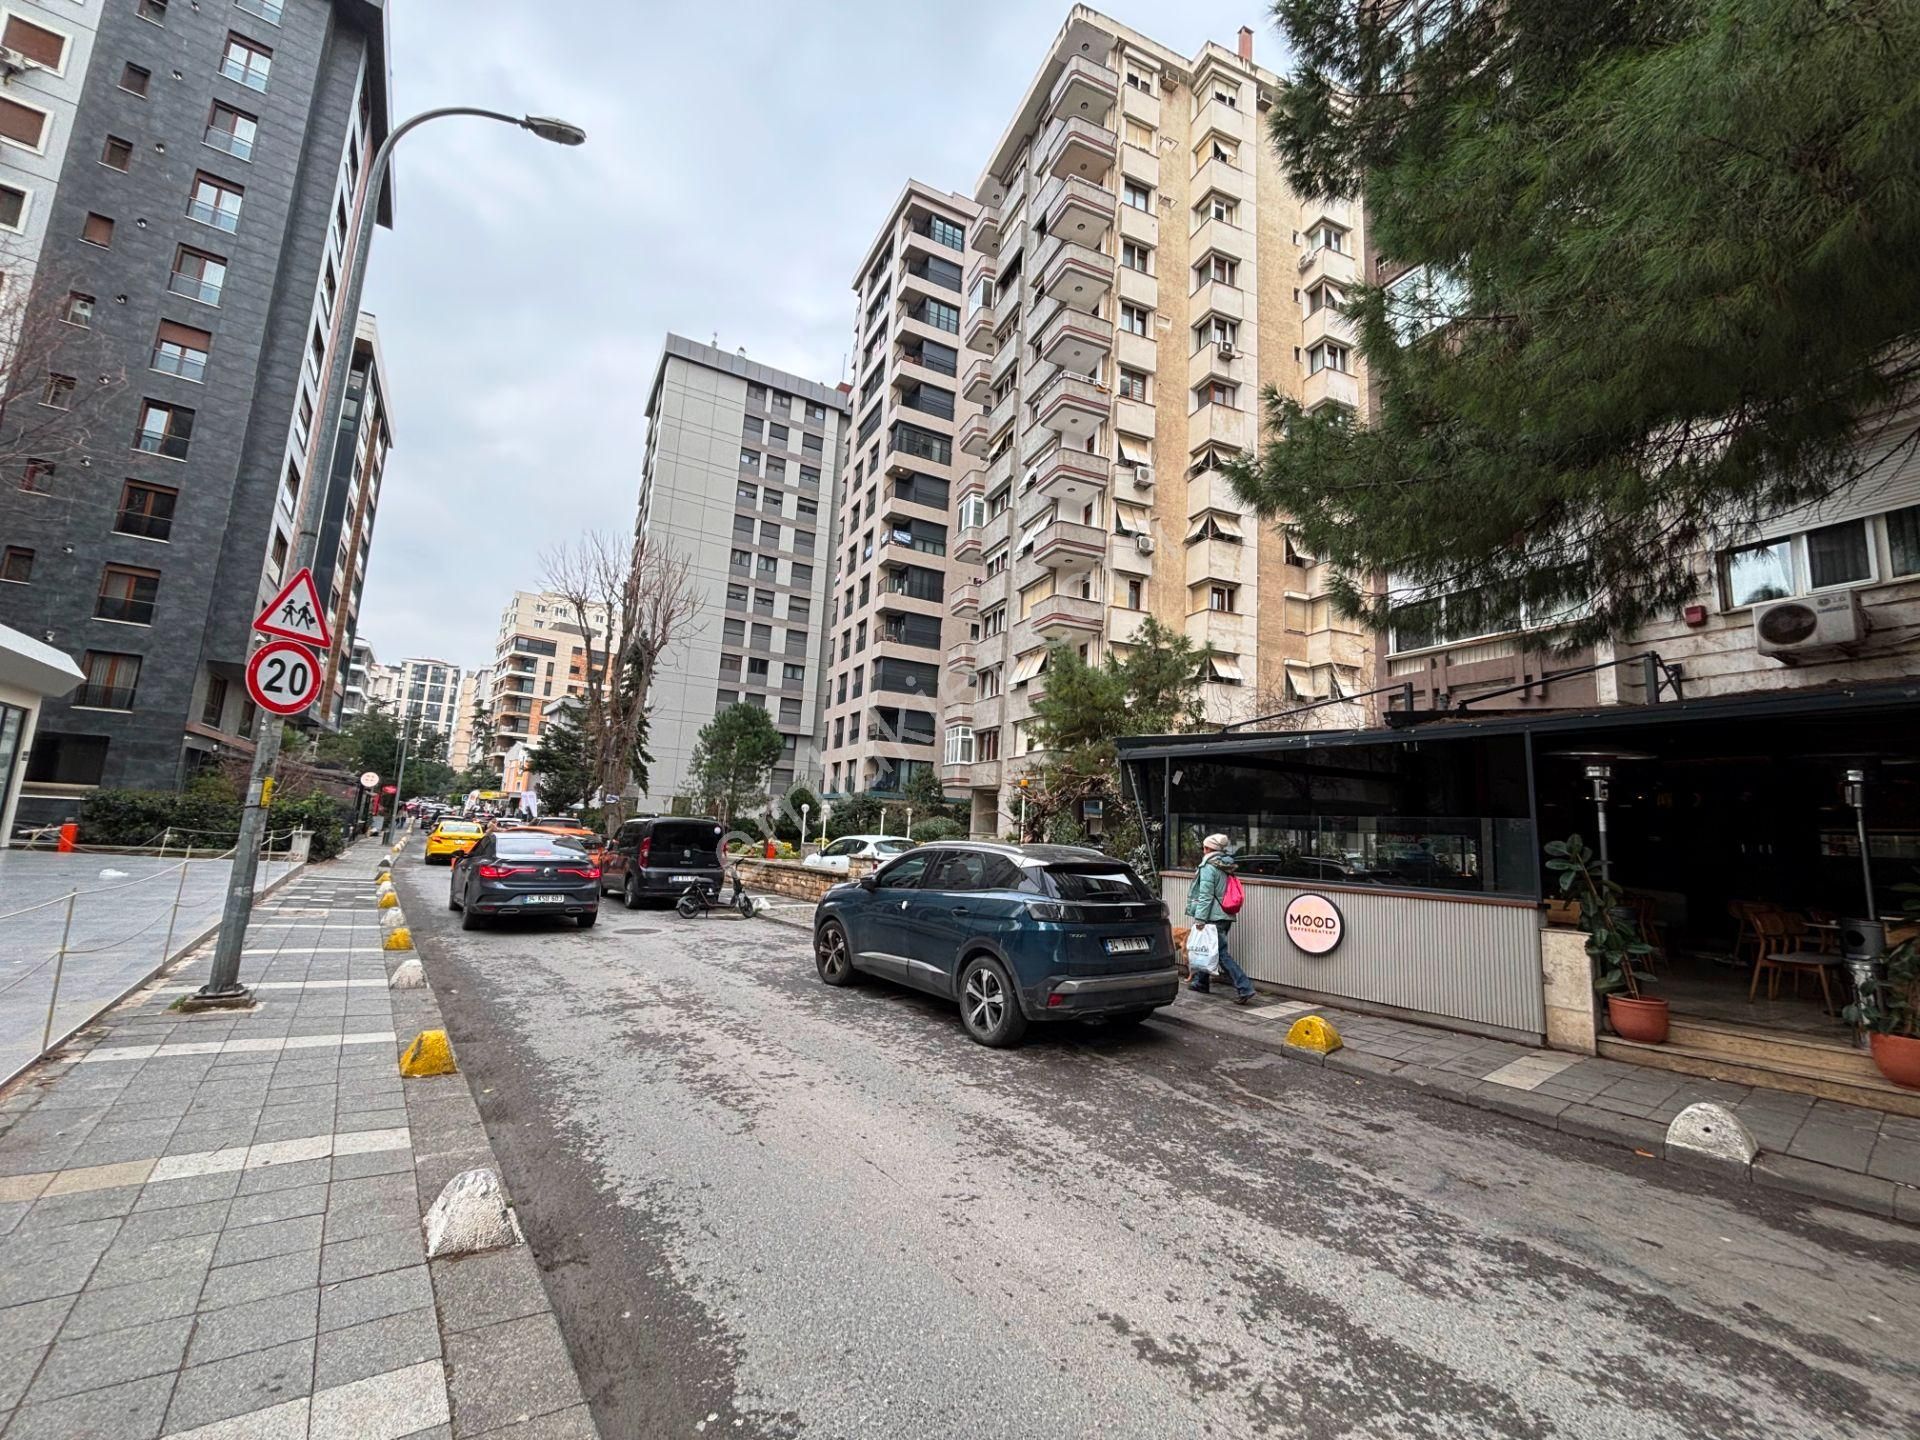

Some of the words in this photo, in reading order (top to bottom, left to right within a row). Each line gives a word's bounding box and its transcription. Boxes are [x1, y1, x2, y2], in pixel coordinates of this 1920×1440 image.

[263, 658, 308, 696] 20
[1290, 913, 1336, 929] MOOD
[1108, 939, 1118, 951] 34
